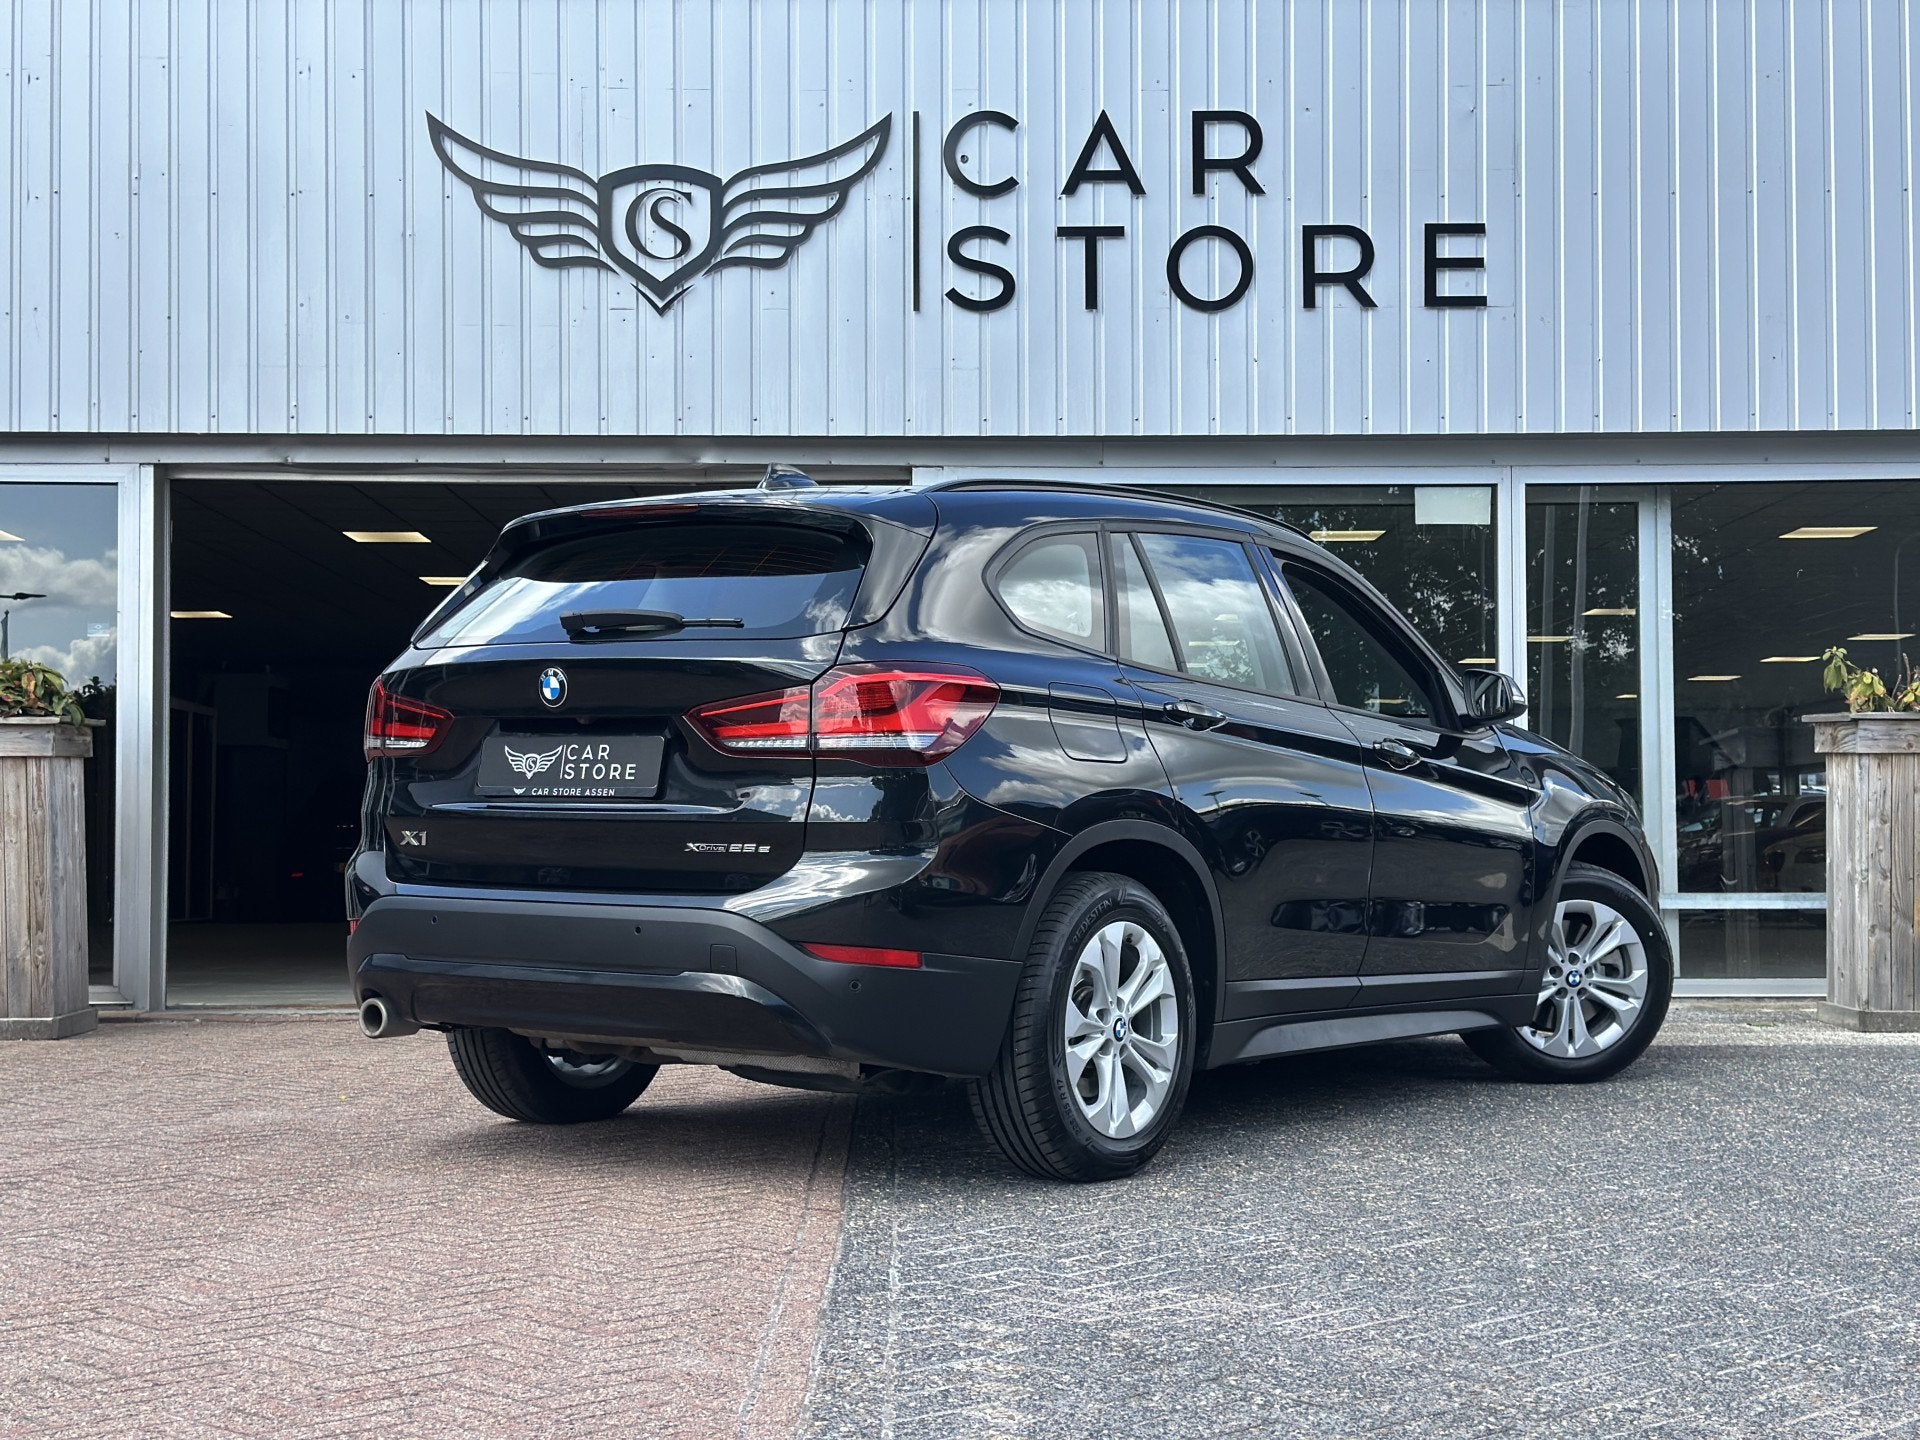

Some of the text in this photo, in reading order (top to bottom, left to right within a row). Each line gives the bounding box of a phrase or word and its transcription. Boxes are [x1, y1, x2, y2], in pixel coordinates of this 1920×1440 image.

[943, 109, 1266, 197] CAR
[944, 223, 1488, 312] STORE
[567, 744, 610, 760] CAR
[564, 763, 637, 780] STORE
[531, 788, 615, 797] CAR STORE ASSEN
[400, 830, 426, 846] X1
